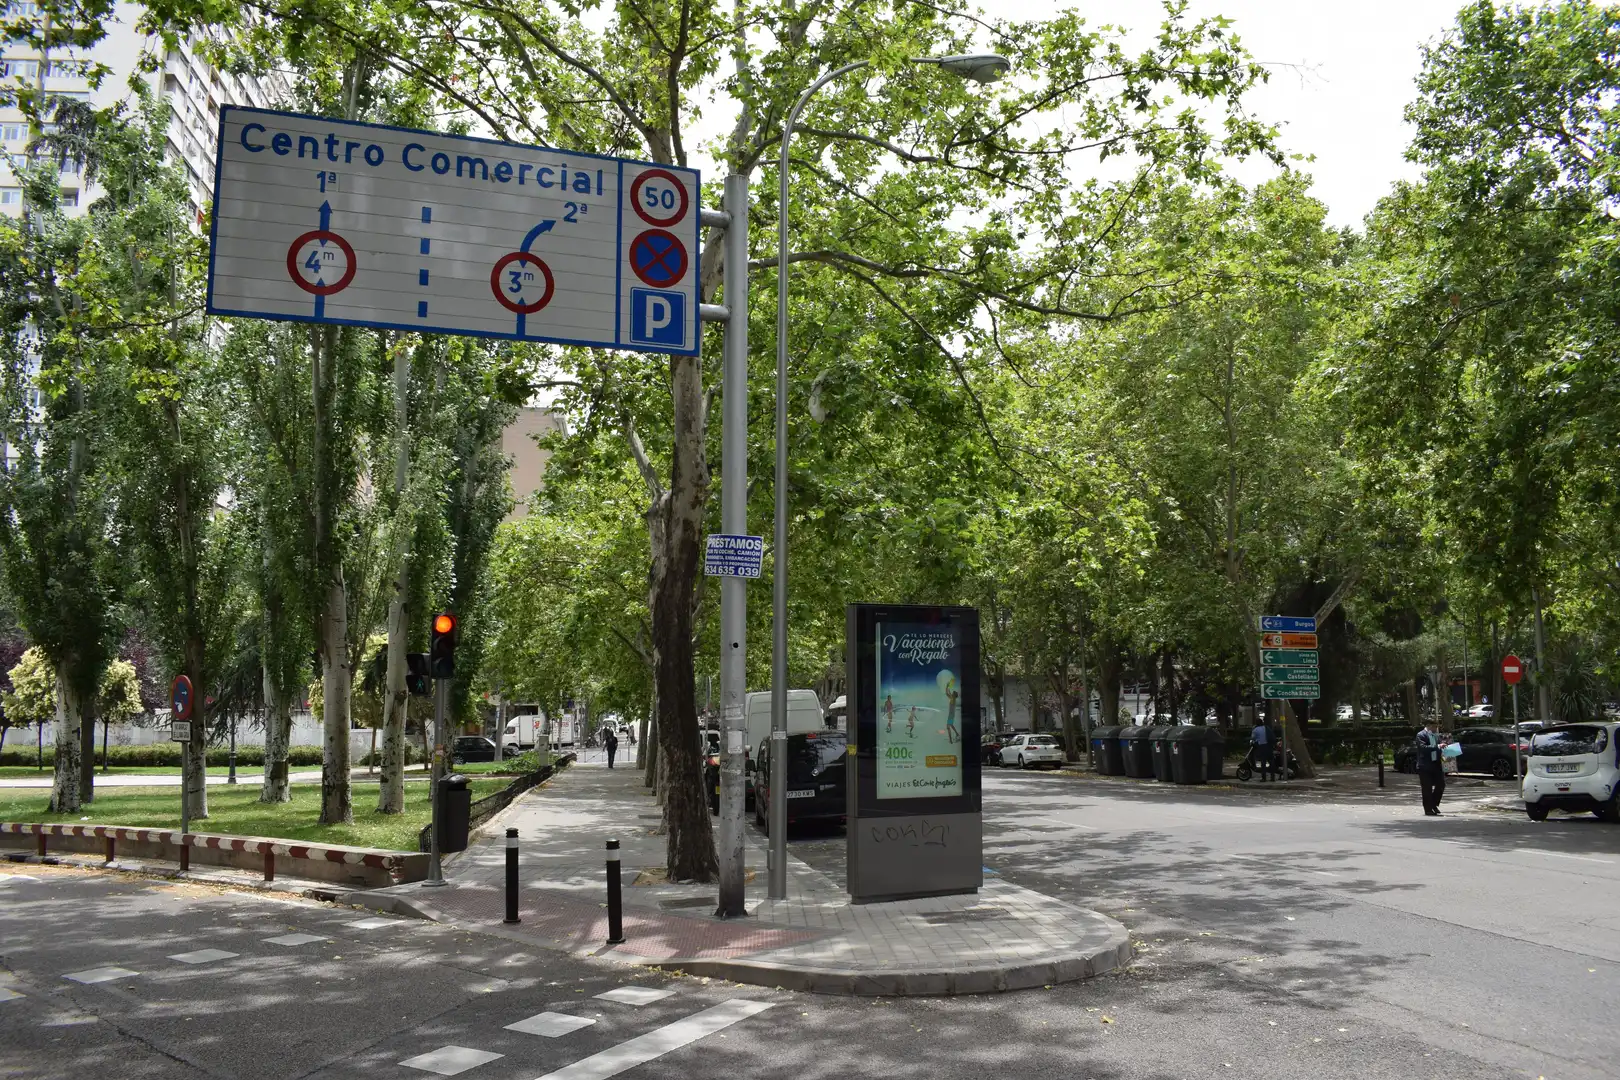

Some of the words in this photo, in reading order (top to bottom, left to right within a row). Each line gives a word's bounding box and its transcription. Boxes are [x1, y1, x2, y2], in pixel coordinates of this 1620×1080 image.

[240, 123, 384, 167] Centro
[402, 143, 604, 196] Comercial
[316, 170, 337, 193] 1ª
[645, 186, 675, 210] 50
[563, 202, 588, 224] 2ª
[645, 295, 672, 338] P
[718, 566, 734, 574] 635
[738, 567, 758, 576] 039
[884, 634, 955, 652] Vacaciones
[910, 647, 949, 665] Regalo
